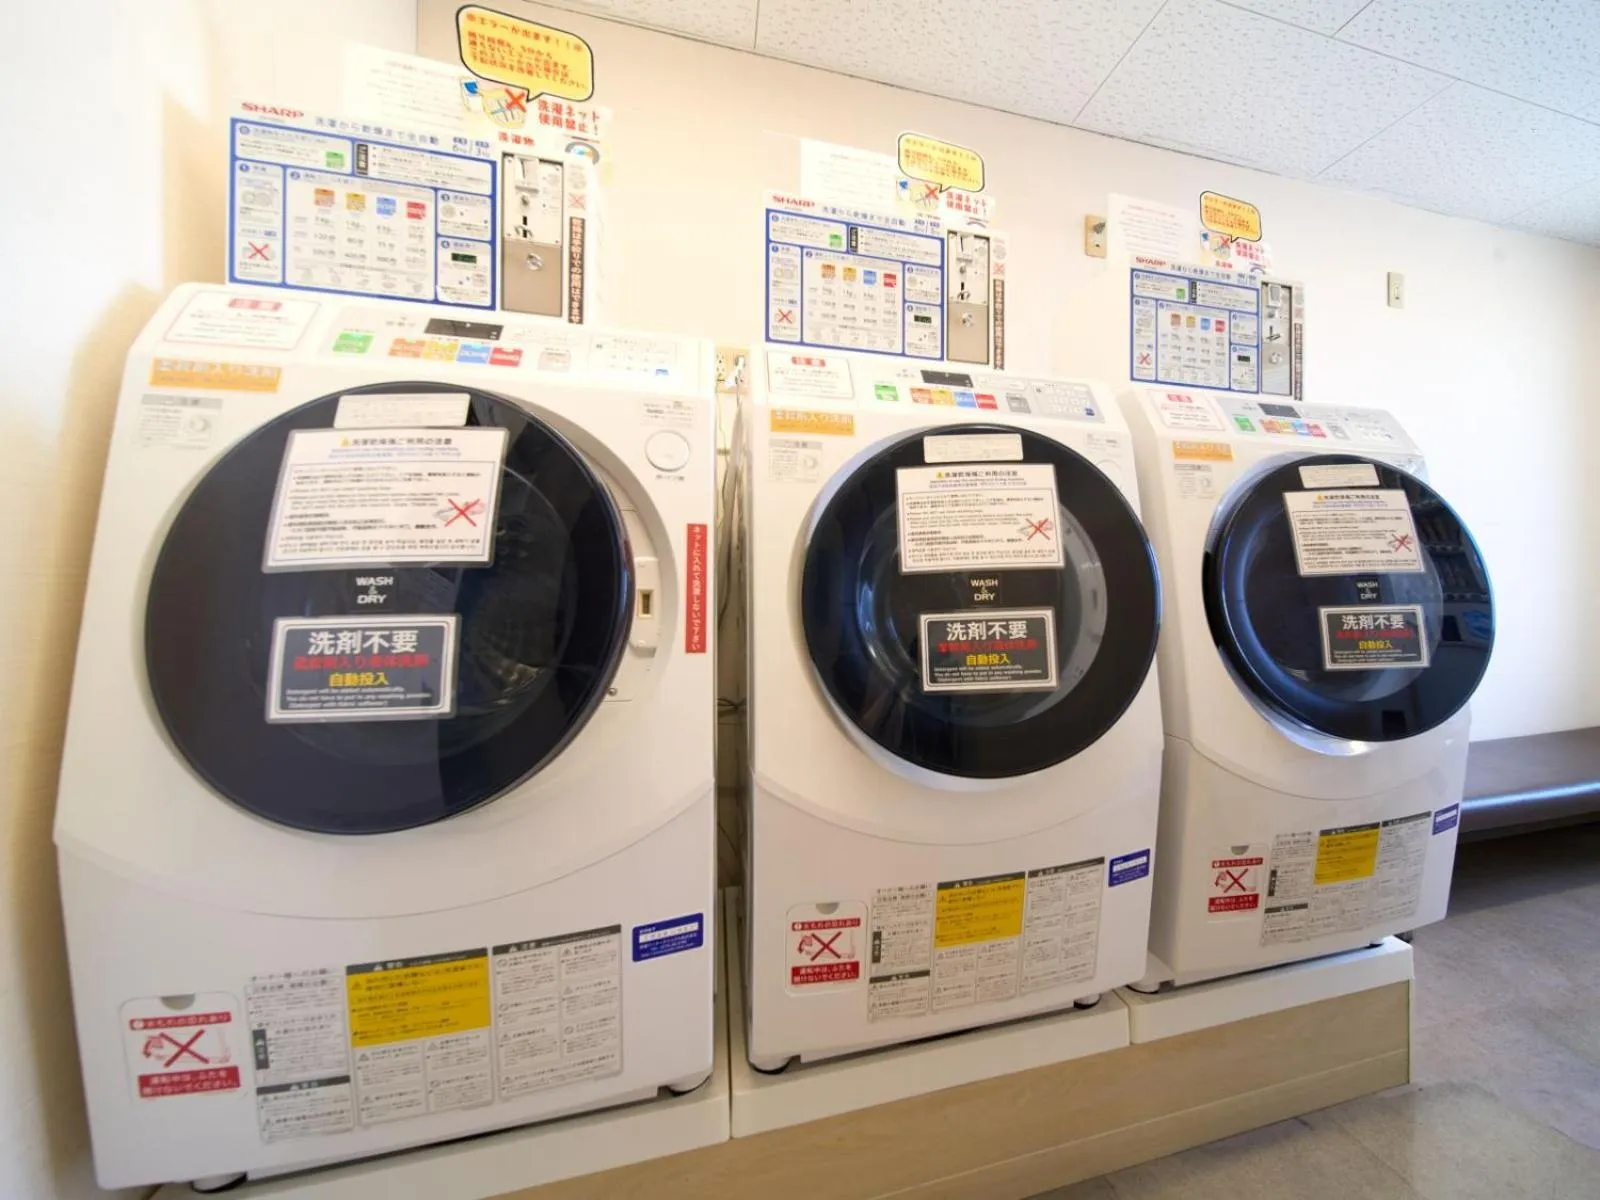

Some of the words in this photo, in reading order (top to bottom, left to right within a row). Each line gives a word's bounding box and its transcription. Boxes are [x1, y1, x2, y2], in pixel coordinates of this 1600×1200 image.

[242, 102, 304, 117] SHARP
[772, 195, 815, 208] SHARP
[1135, 256, 1167, 267] SHARP
[356, 577, 394, 586] WASH
[970, 579, 999, 587] WASH
[1356, 581, 1378, 589] WASH
[357, 594, 387, 604] DRY
[974, 593, 996, 601] DRY
[1342, 614, 1405, 630] 洗剤不要
[946, 620, 1028, 641] 洗剤不要
[308, 630, 418, 655] 洗剤不要
[966, 654, 1010, 665] 自動投入
[328, 672, 389, 687] 自動投入
